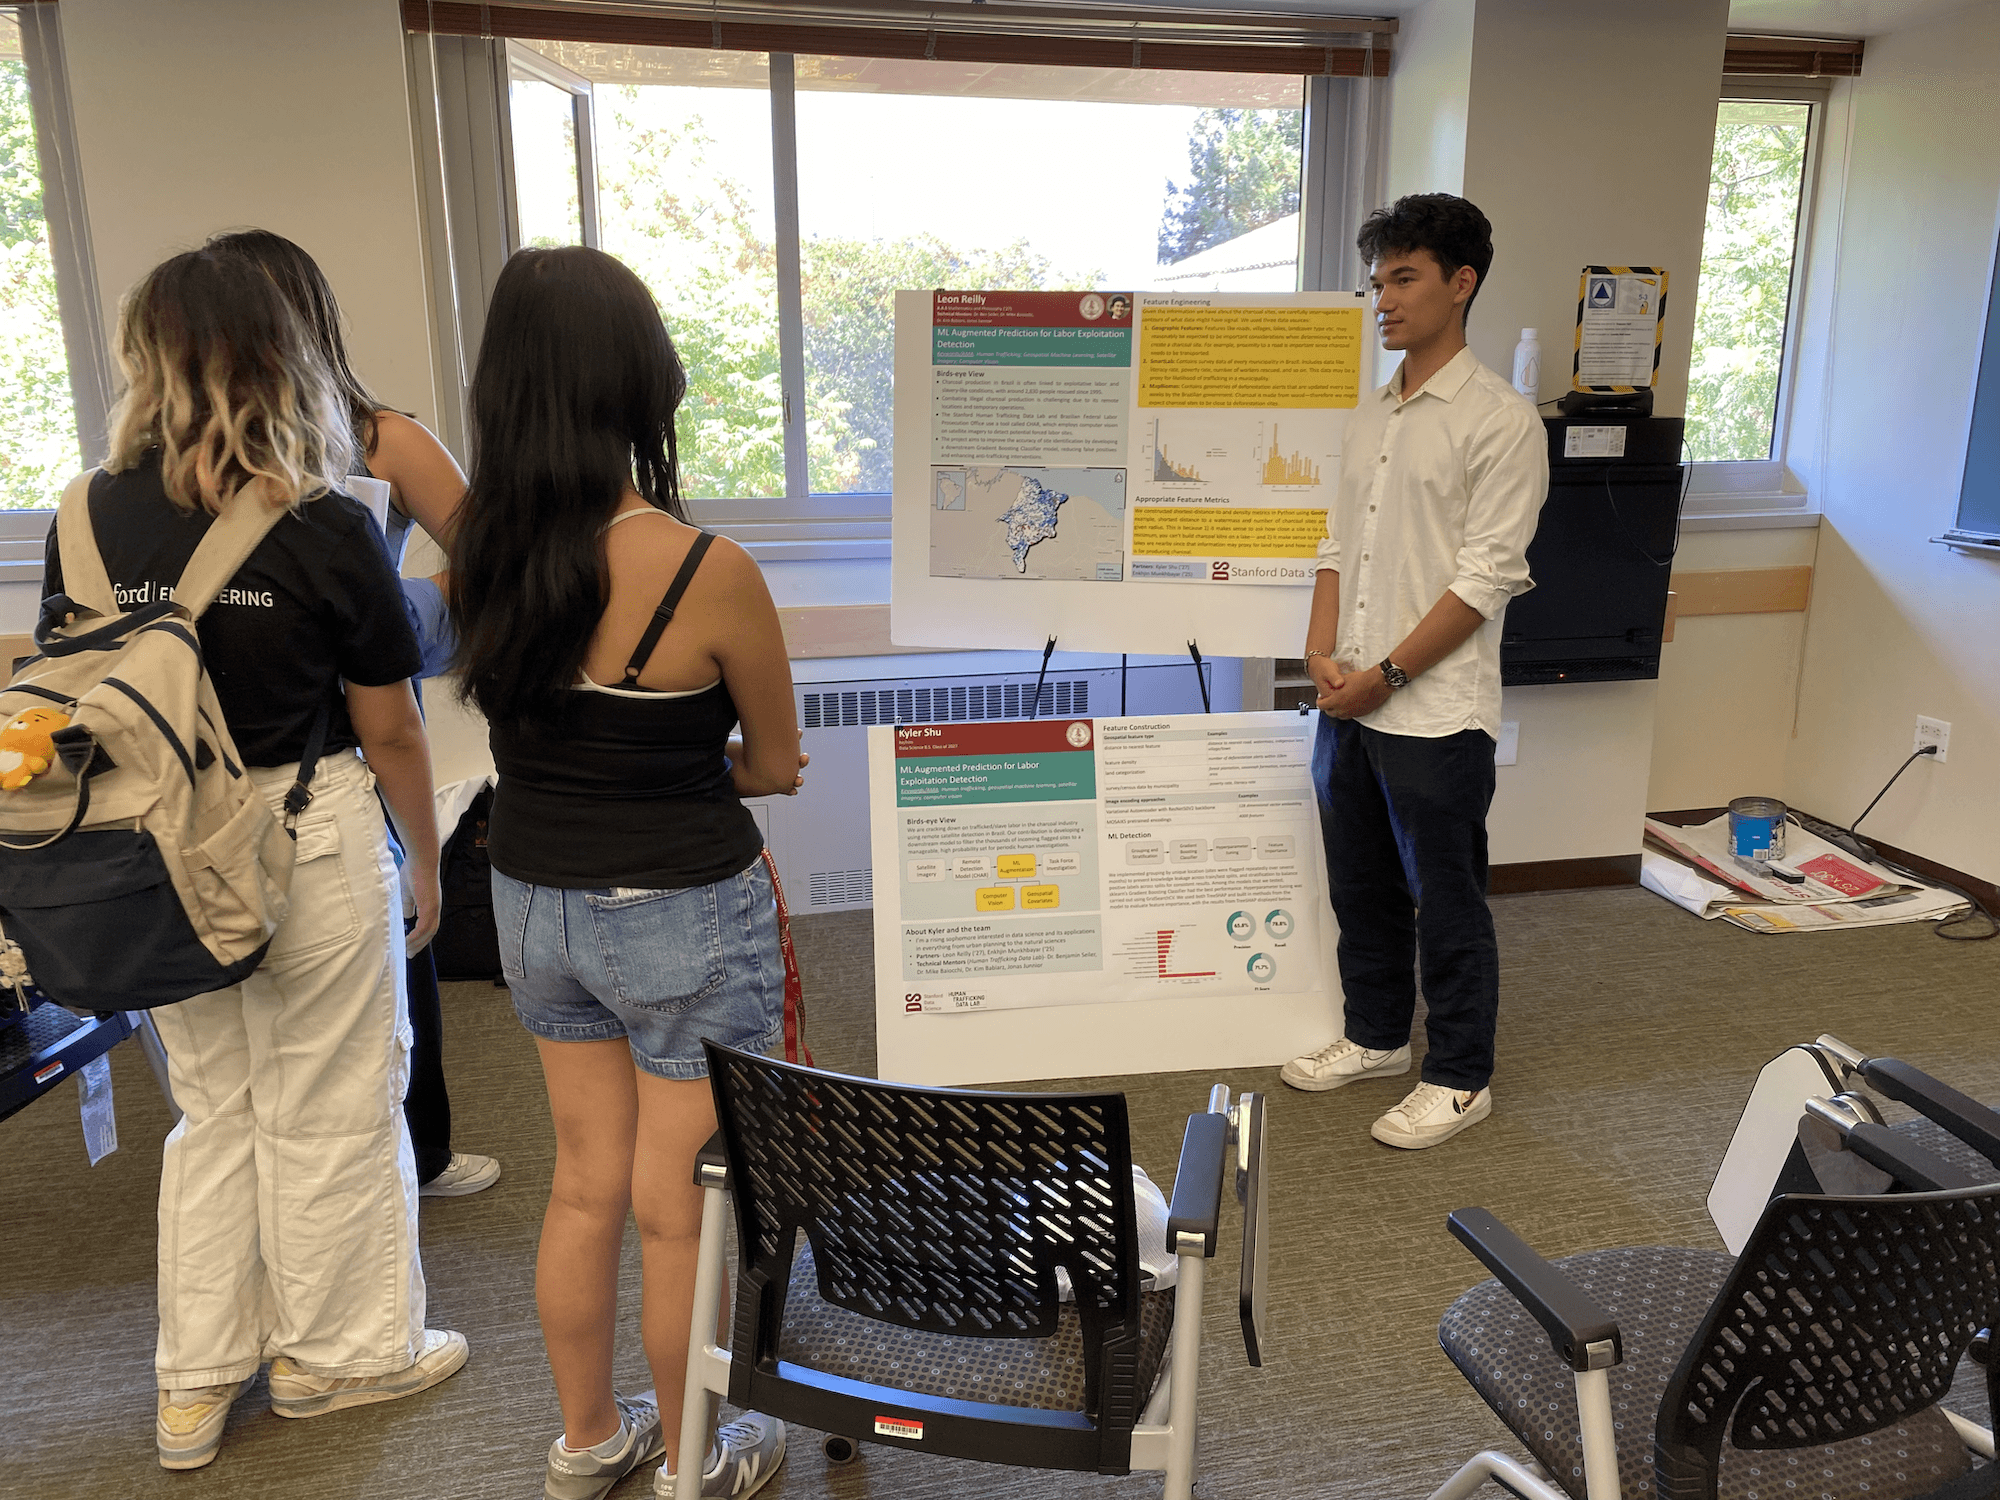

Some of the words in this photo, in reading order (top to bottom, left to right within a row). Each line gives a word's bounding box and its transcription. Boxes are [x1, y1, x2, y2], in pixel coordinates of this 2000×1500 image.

[937, 295, 959, 303] Leon
[961, 295, 986, 305] Reilly
[1170, 299, 1211, 307] Engineering
[937, 328, 950, 336] ML
[950, 329, 997, 338] Augmented
[998, 329, 1039, 337] Prediction
[1040, 329, 1051, 337] for
[1077, 330, 1125, 340] Exploitation
[937, 340, 975, 348] Detection
[936, 370, 967, 379] Birds-eye
[1135, 496, 1176, 504] Appropriate
[1212, 562, 1229, 580] DS
[1231, 567, 1277, 577] Stanford
[1281, 568, 1305, 577] Data
[114, 581, 150, 604] ford
[159, 586, 274, 608] EERING
[1129, 723, 1170, 731] Construction
[898, 729, 923, 739] Kyler
[924, 728, 942, 737] Shu
[900, 766, 913, 774] ML
[914, 764, 961, 775] Augmented
[962, 762, 1002, 771] Prediction
[1004, 762, 1015, 770] for
[1017, 761, 1039, 769] Labor
[900, 776, 948, 788] Exploitation
[949, 774, 988, 784] Detection
[906, 817, 938, 827] Birds-eye
[939, 816, 956, 824] View
[1119, 831, 1152, 839] Detection
[762, 849, 778, 879] Stanford
[905, 928, 927, 936] About
[928, 927, 945, 936] Kyler
[960, 925, 972, 933] the
[973, 924, 991, 932] team
[946, 935, 976, 943] sophomore
[1064, 928, 1095, 936] applications
[922, 944, 951, 952] everything
[905, 993, 922, 1012] DS
[551, 1461, 573, 1474] balance
[556, 1458, 569, 1467] new
[731, 1451, 760, 1495] N
